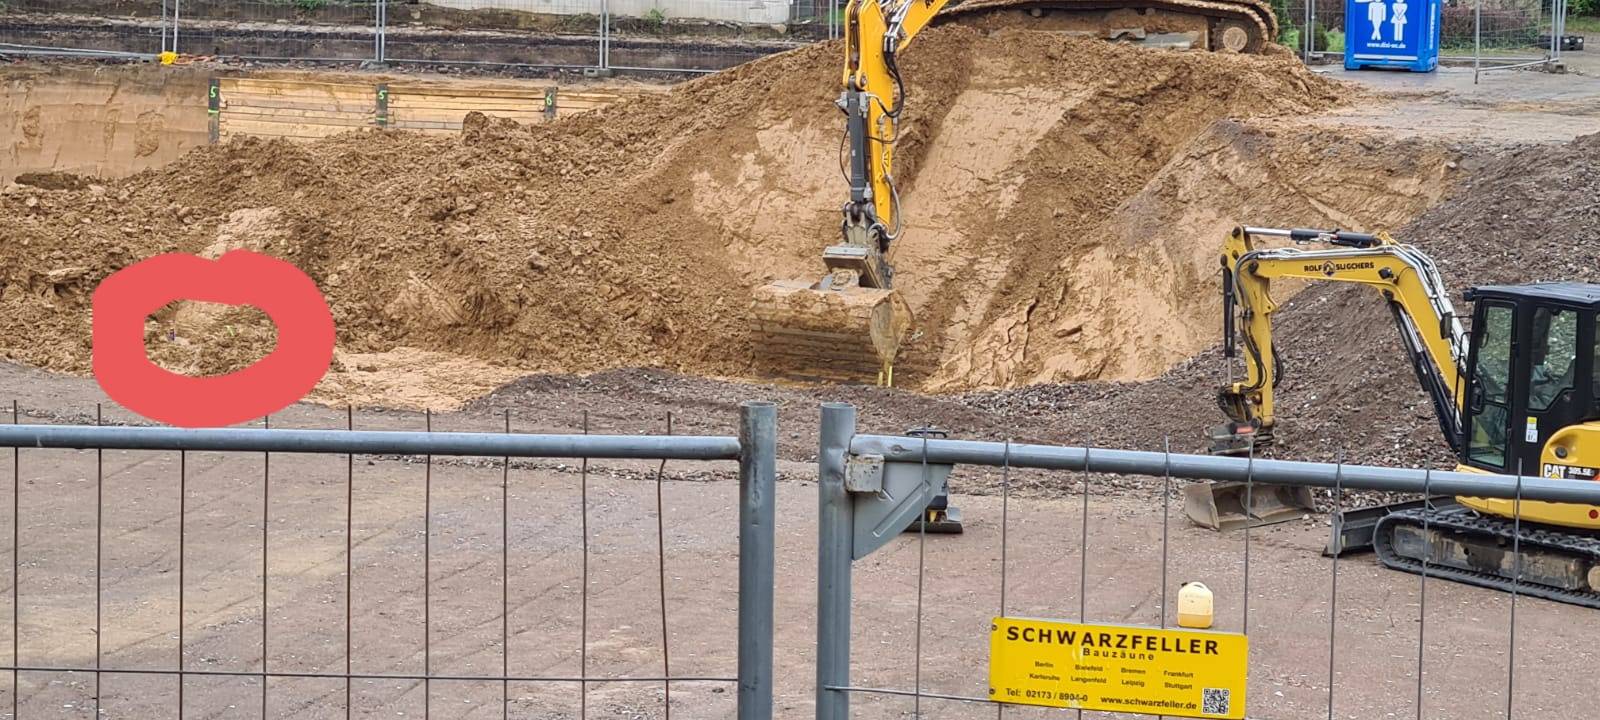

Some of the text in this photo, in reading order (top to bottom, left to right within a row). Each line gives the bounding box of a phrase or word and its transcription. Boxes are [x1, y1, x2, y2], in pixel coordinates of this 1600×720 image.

[210, 86, 218, 98] 5
[379, 90, 387, 100] 5
[547, 93, 553, 106] 6
[1544, 464, 1566, 479] CAT
[1006, 626, 1219, 655] SCHWARZFELLER
[1082, 647, 1155, 661] Bauzäune
[1075, 664, 1103, 672] Bielefeld
[1164, 670, 1193, 678] Frankfurt
[1029, 673, 1193, 690] Karlsruhe Langenfeld Leipzig Stuttgart
[1006, 688, 1021, 696] Tel:
[1026, 690, 1052, 699] 02173
[1100, 696, 1197, 710] www.schwarzfeller.de
